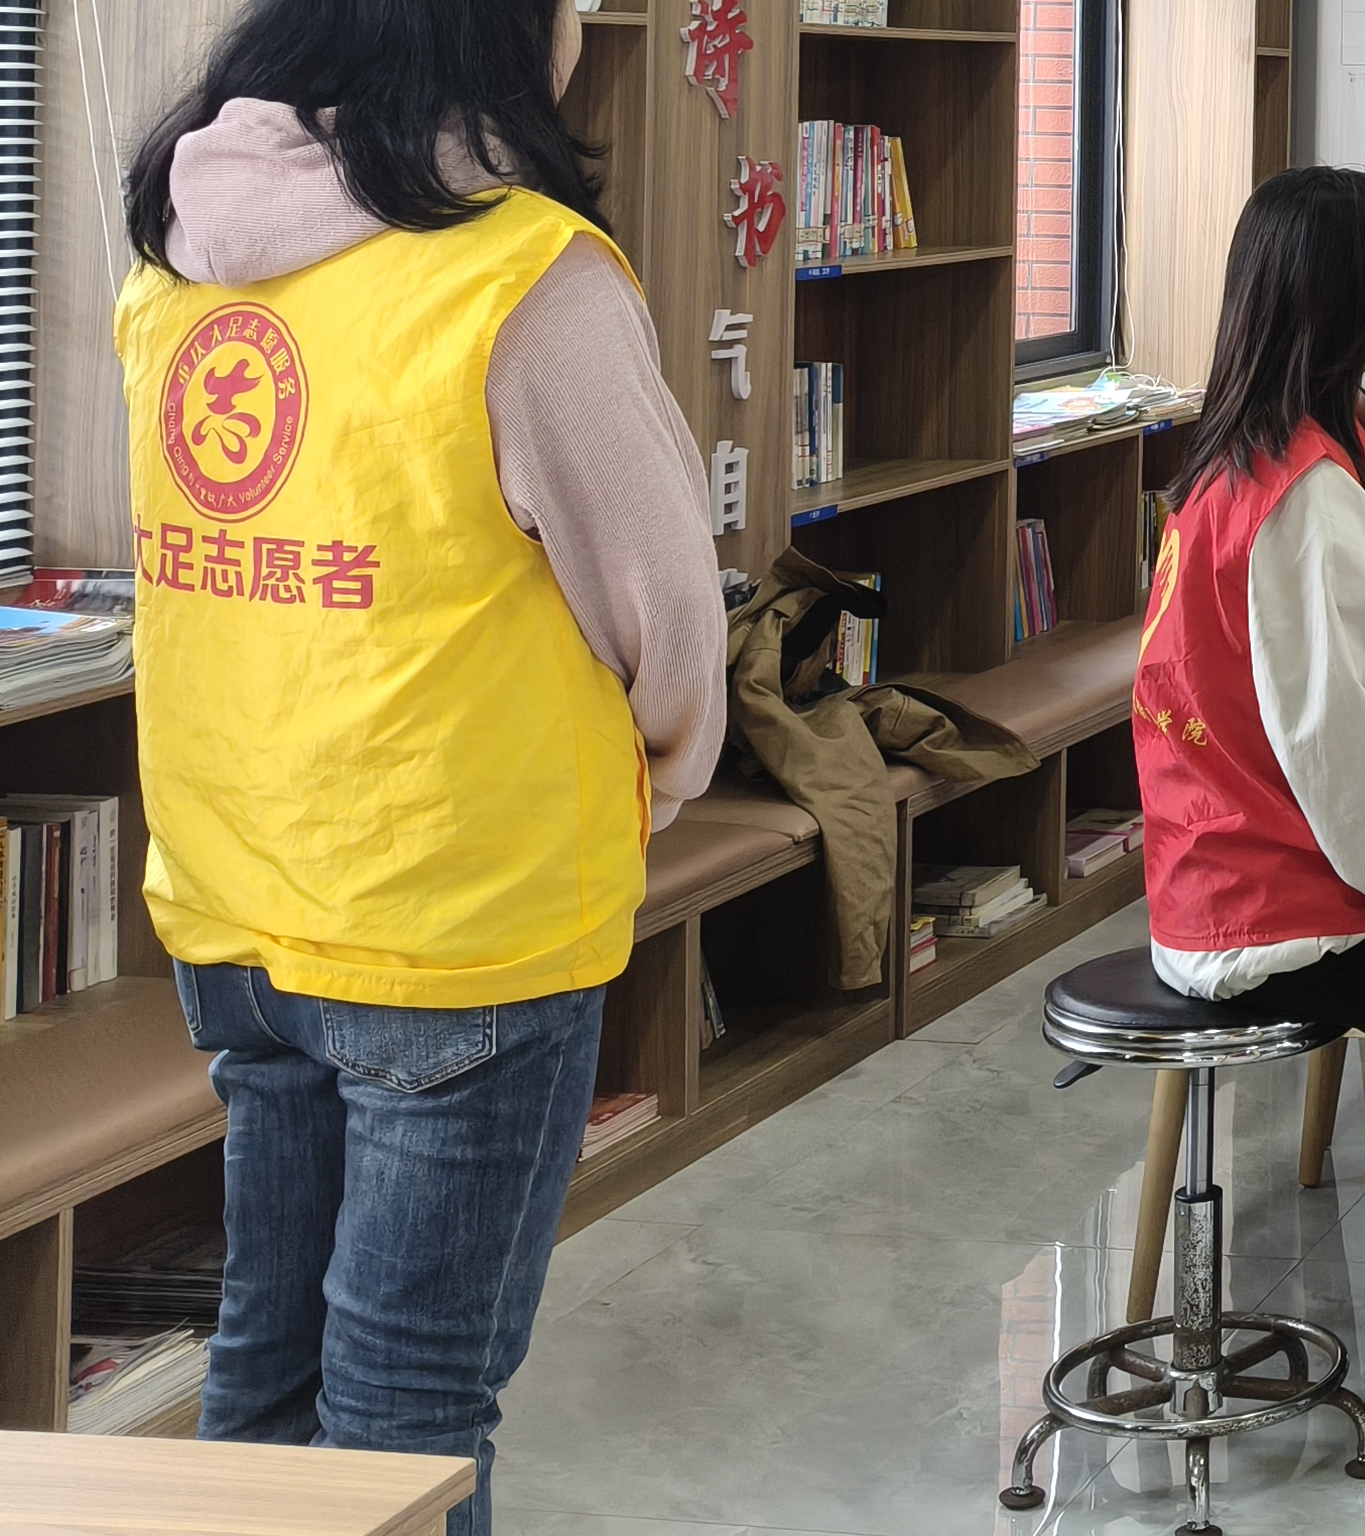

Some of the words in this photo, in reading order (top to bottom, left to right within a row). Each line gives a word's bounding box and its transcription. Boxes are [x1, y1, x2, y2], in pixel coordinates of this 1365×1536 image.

[272, 415, 295, 465] Service
[134, 513, 381, 611] 大足志愿者
